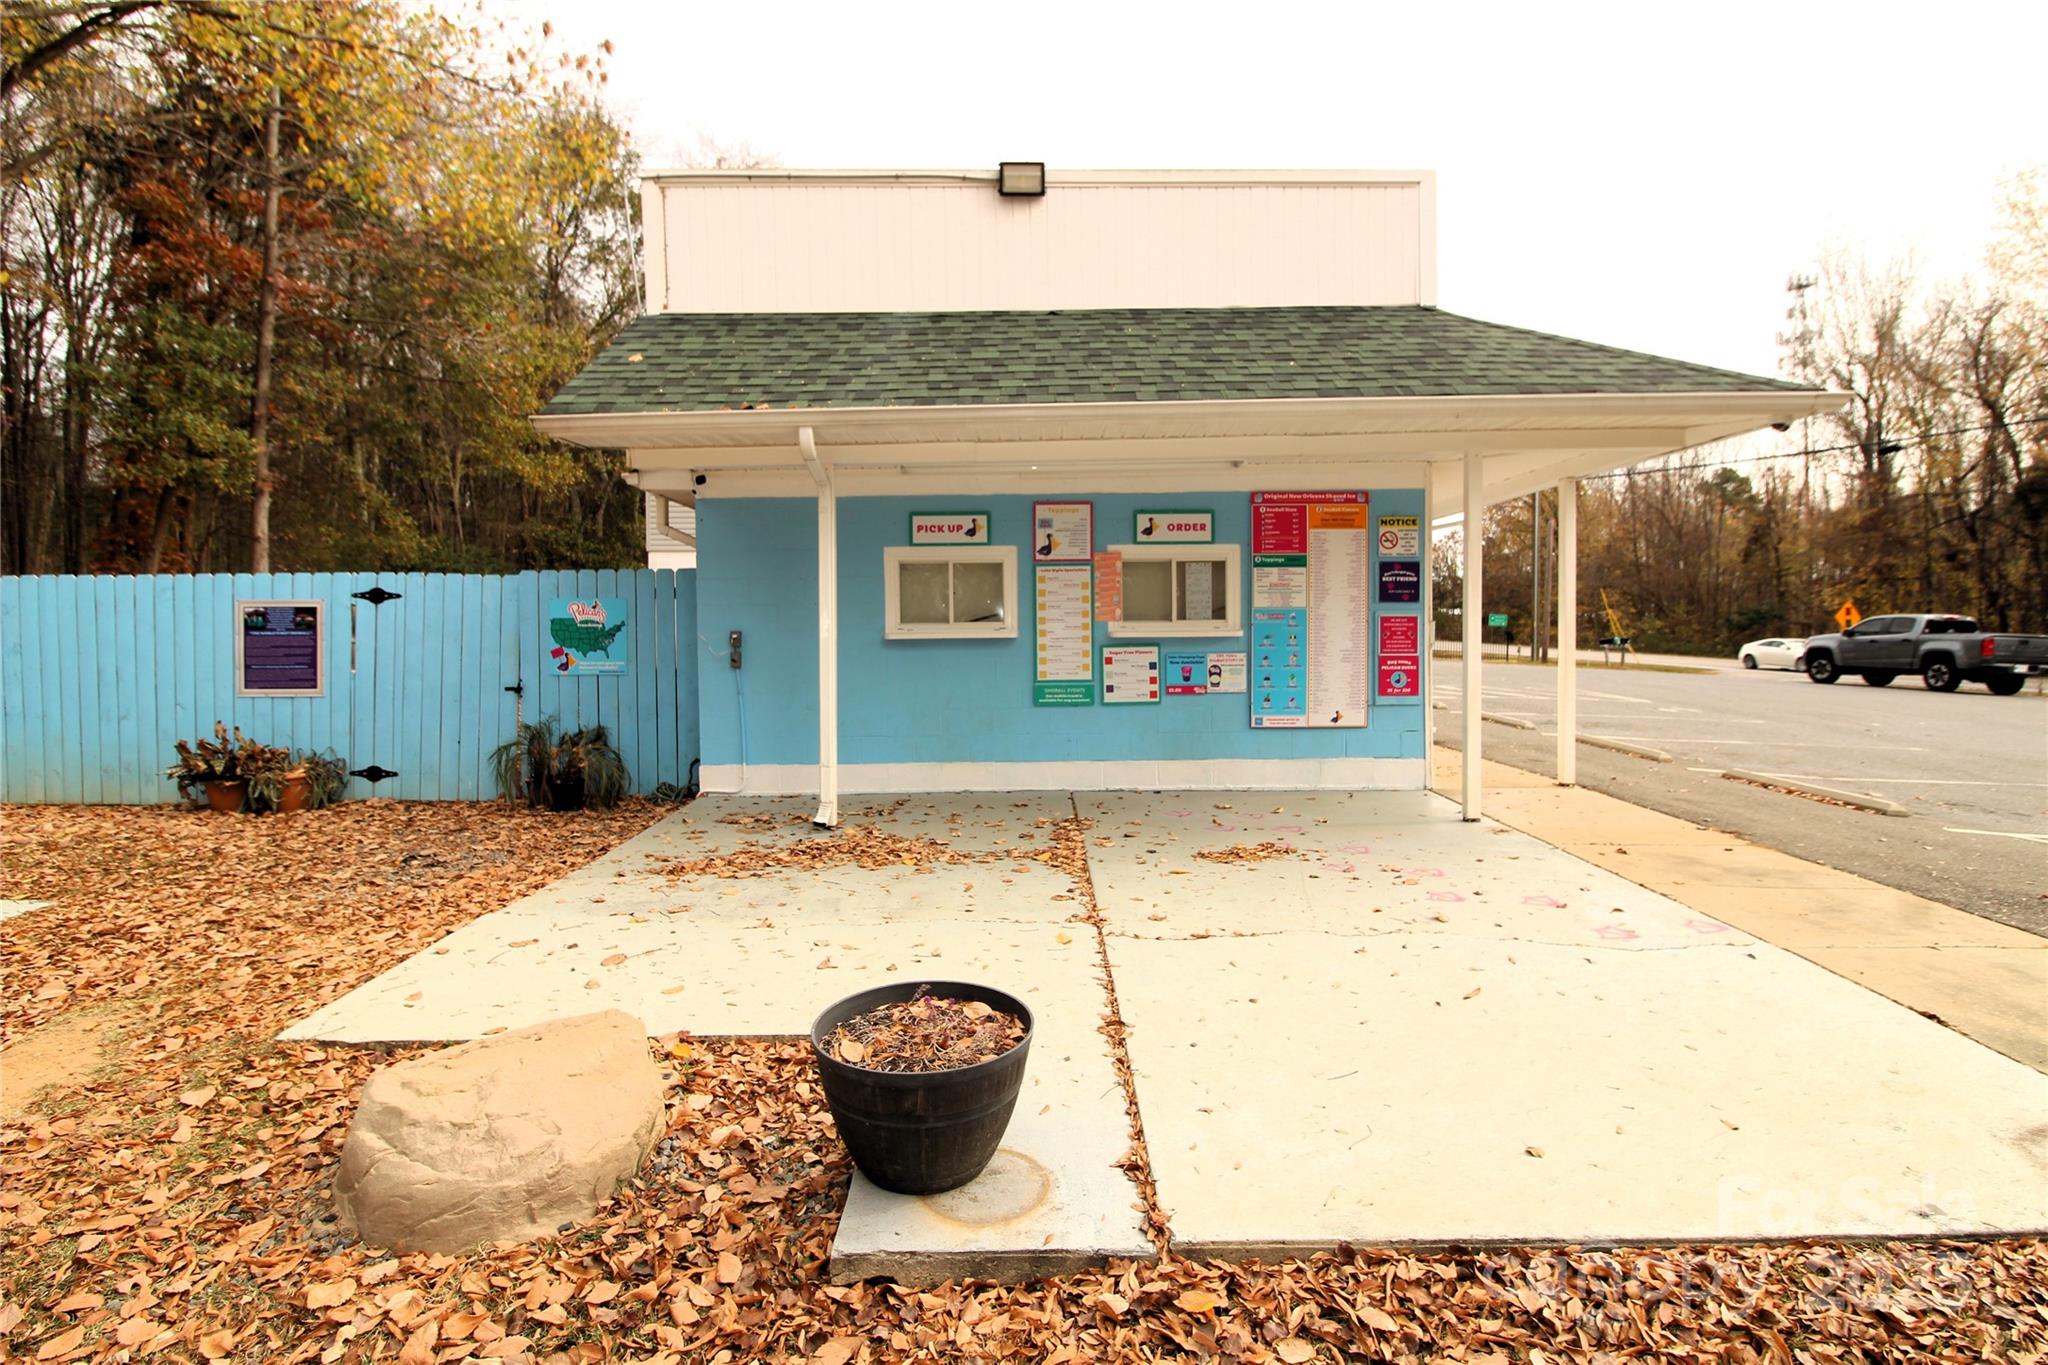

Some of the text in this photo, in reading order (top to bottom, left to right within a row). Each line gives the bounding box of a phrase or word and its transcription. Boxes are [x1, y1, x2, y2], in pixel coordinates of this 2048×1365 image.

[1380, 518, 1418, 526] NOTICE
[917, 524, 964, 533] PICK UP
[1167, 523, 1207, 532] ORDER
